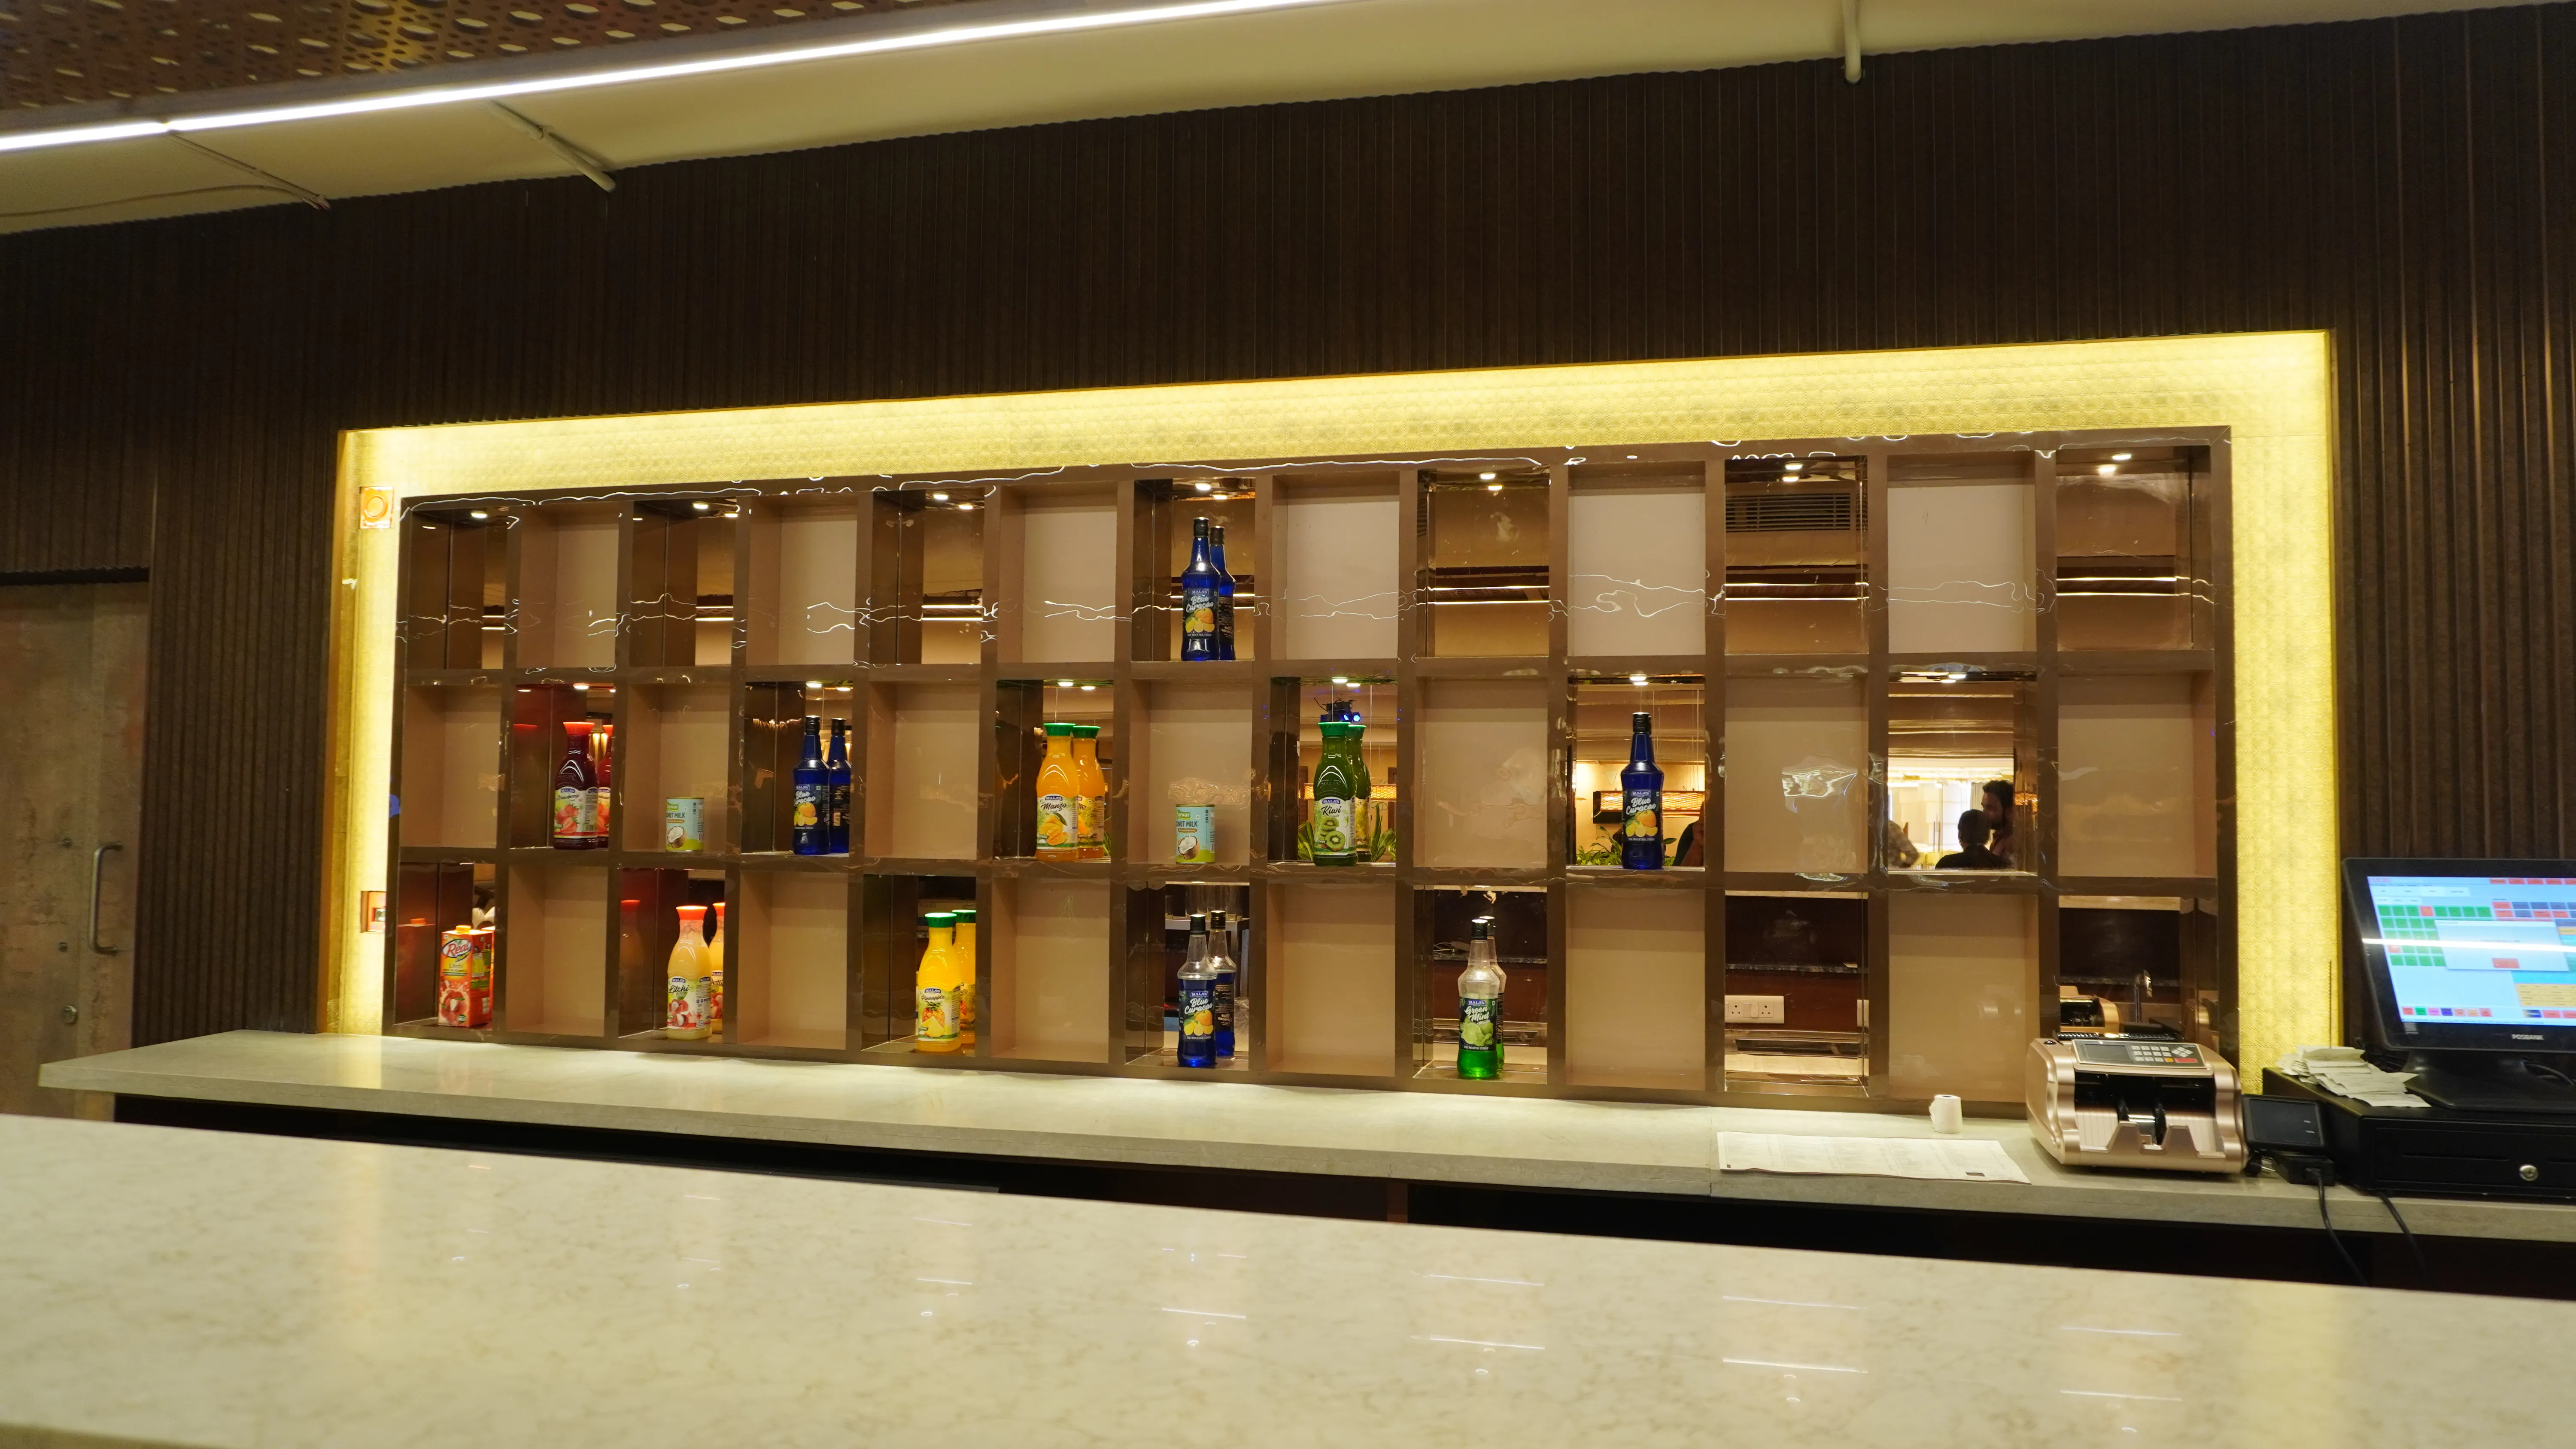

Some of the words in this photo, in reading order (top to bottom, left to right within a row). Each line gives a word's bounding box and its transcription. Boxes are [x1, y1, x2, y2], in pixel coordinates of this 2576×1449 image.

[1191, 595, 1209, 605] Blue
[796, 791, 810, 800] Blue
[1041, 803, 1067, 811] Mango
[1631, 797, 1651, 807] Blue
[1321, 805, 1342, 815] Kiwi
[1626, 803, 1656, 815] Curacao
[446, 941, 470, 957] Real
[669, 985, 689, 993] Litchi
[1190, 998, 1209, 1007] Blue
[1185, 1003, 1212, 1014] Curacao
[1464, 1006, 1488, 1017] Green
[1468, 1011, 1490, 1022] Mint
